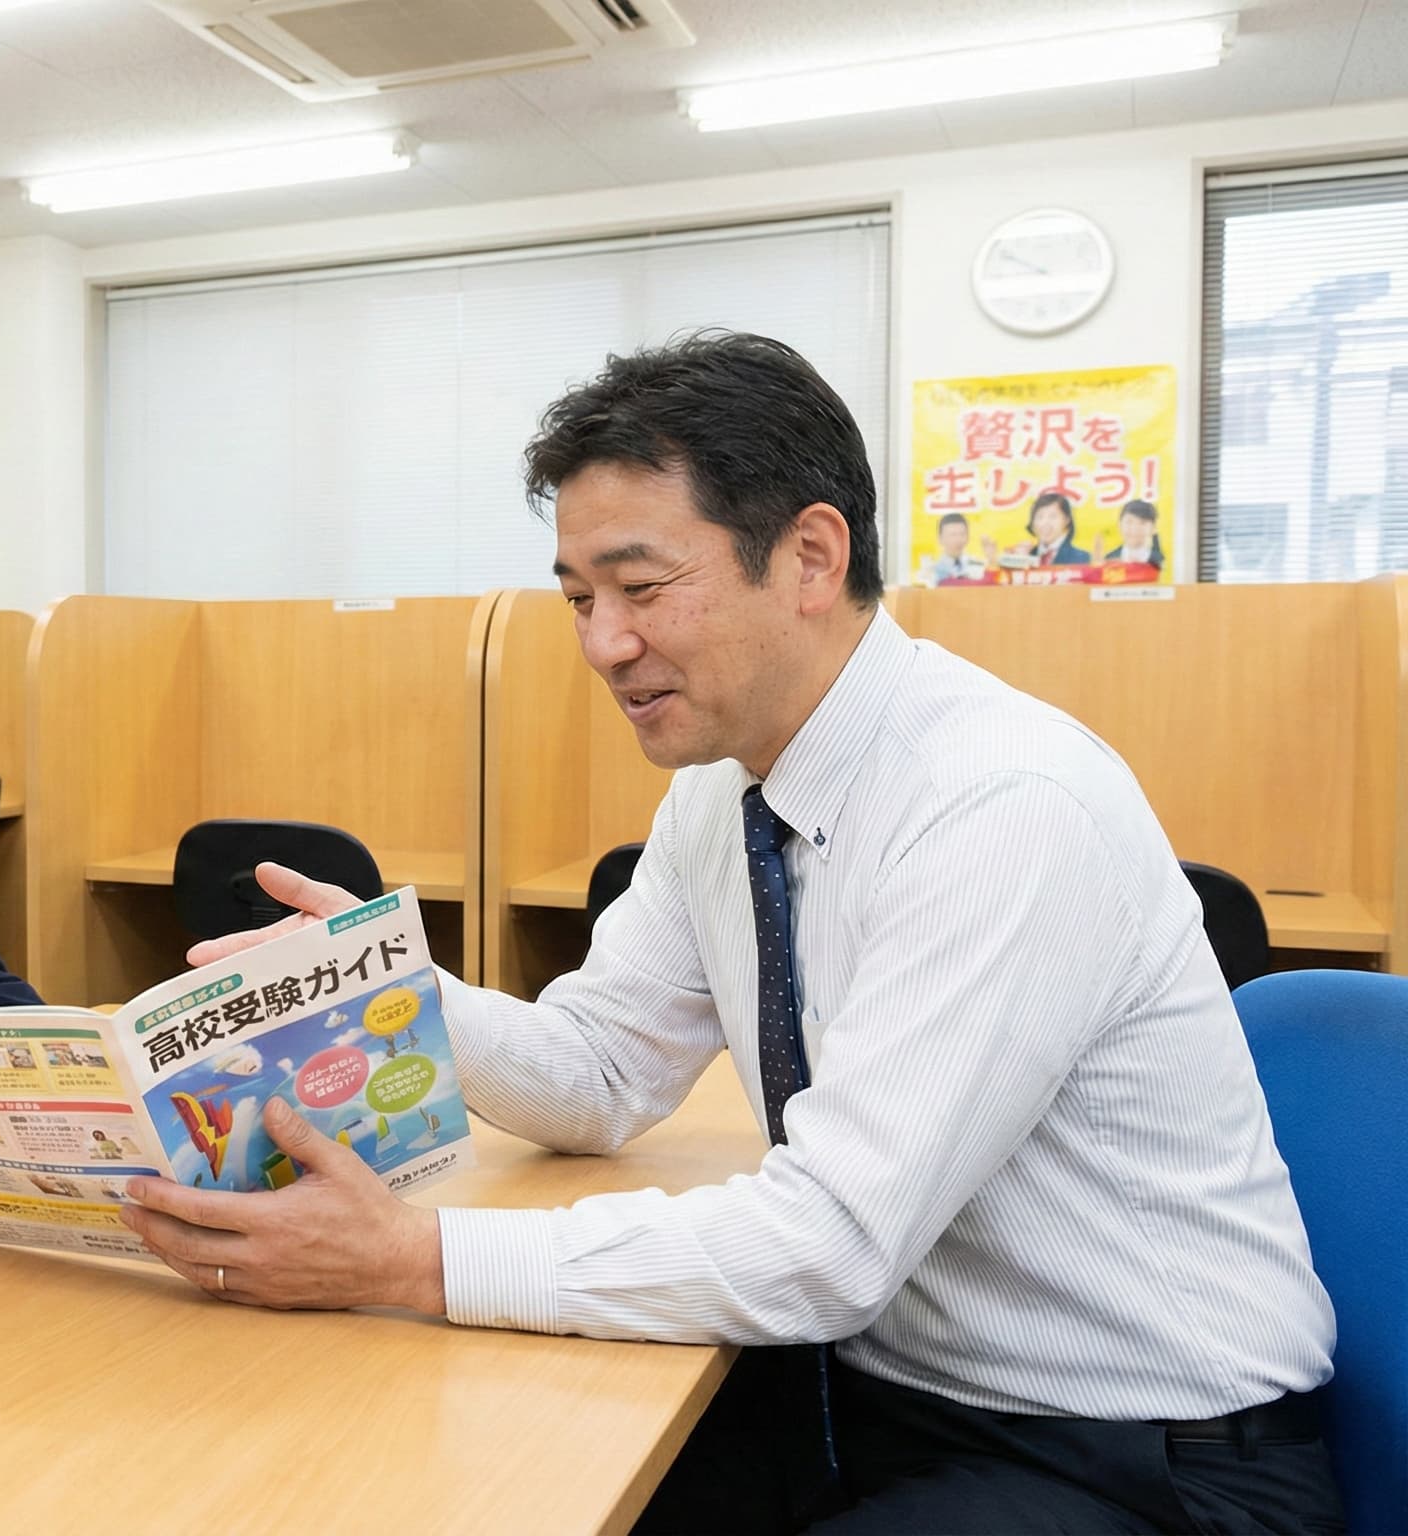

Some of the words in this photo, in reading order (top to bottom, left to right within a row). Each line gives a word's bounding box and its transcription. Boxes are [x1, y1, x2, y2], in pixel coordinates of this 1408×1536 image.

[962, 408, 1121, 461] 贅沢を
[142, 933, 409, 1074] 高校受験ガイド
